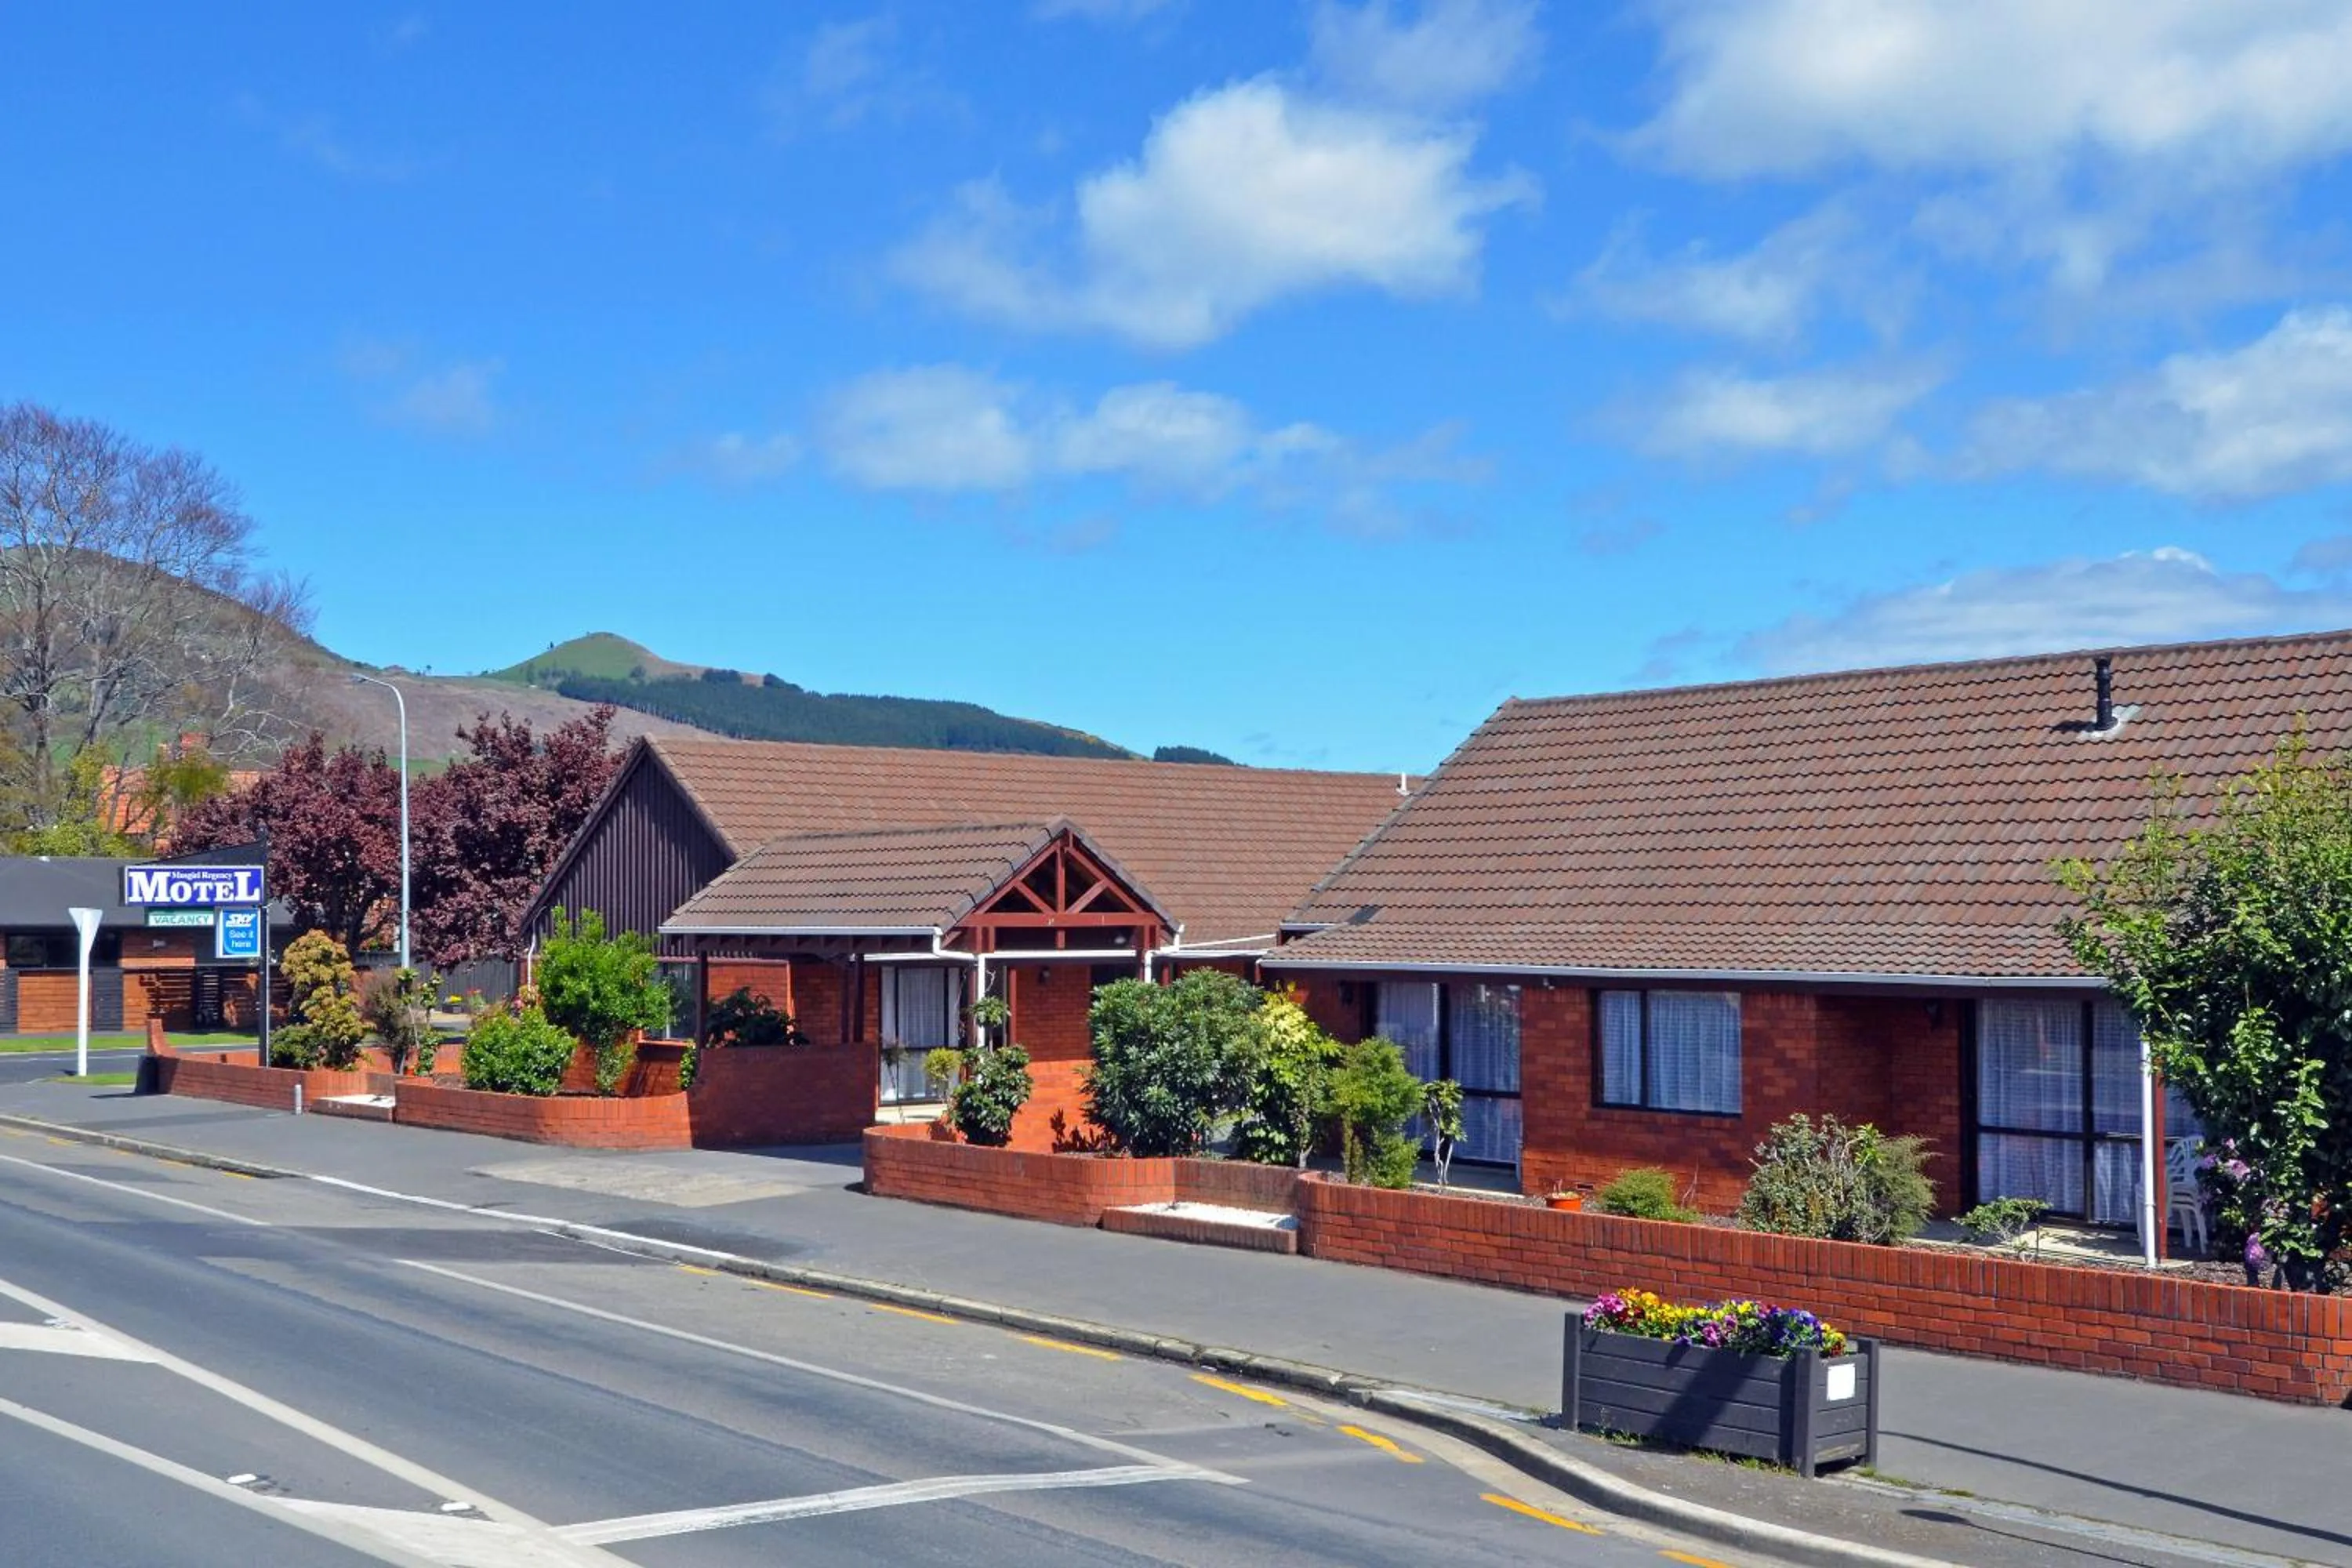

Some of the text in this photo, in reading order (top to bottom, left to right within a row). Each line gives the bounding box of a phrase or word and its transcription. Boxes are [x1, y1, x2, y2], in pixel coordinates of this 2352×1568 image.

[128, 871, 260, 902] MOTEL
[154, 915, 209, 924] VACANCY
[226, 913, 256, 927] SKY
[228, 930, 254, 938] See it
